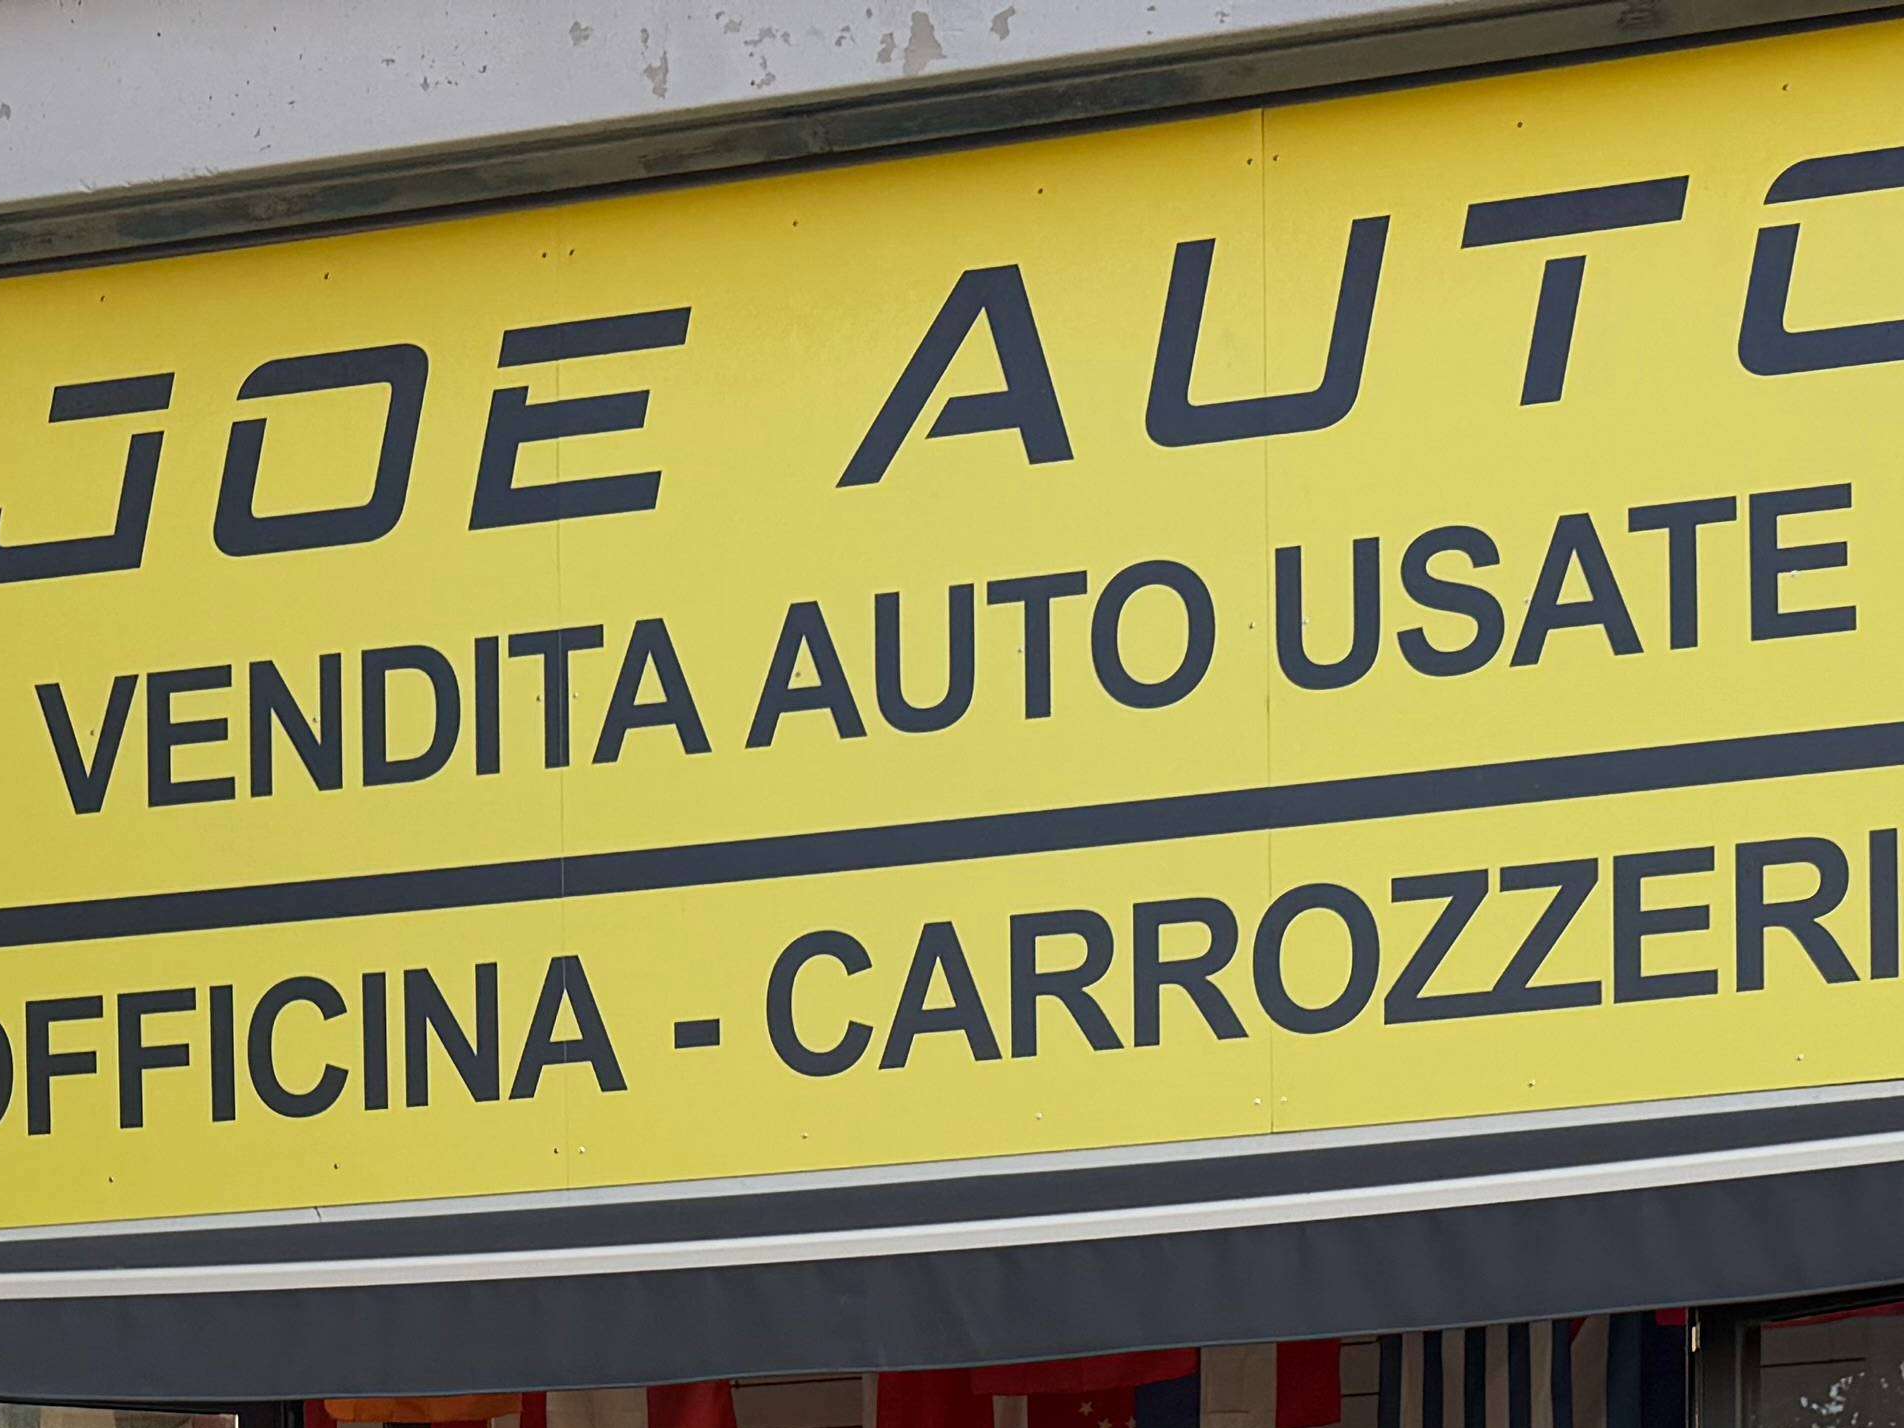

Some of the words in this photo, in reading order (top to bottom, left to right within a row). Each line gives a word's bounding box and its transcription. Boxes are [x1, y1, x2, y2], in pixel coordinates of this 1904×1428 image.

[35, 618, 712, 814] VENDITA
[745, 560, 1215, 748] AUTO
[1275, 483, 1856, 690] USATE
[674, 1018, 720, 1049] -
